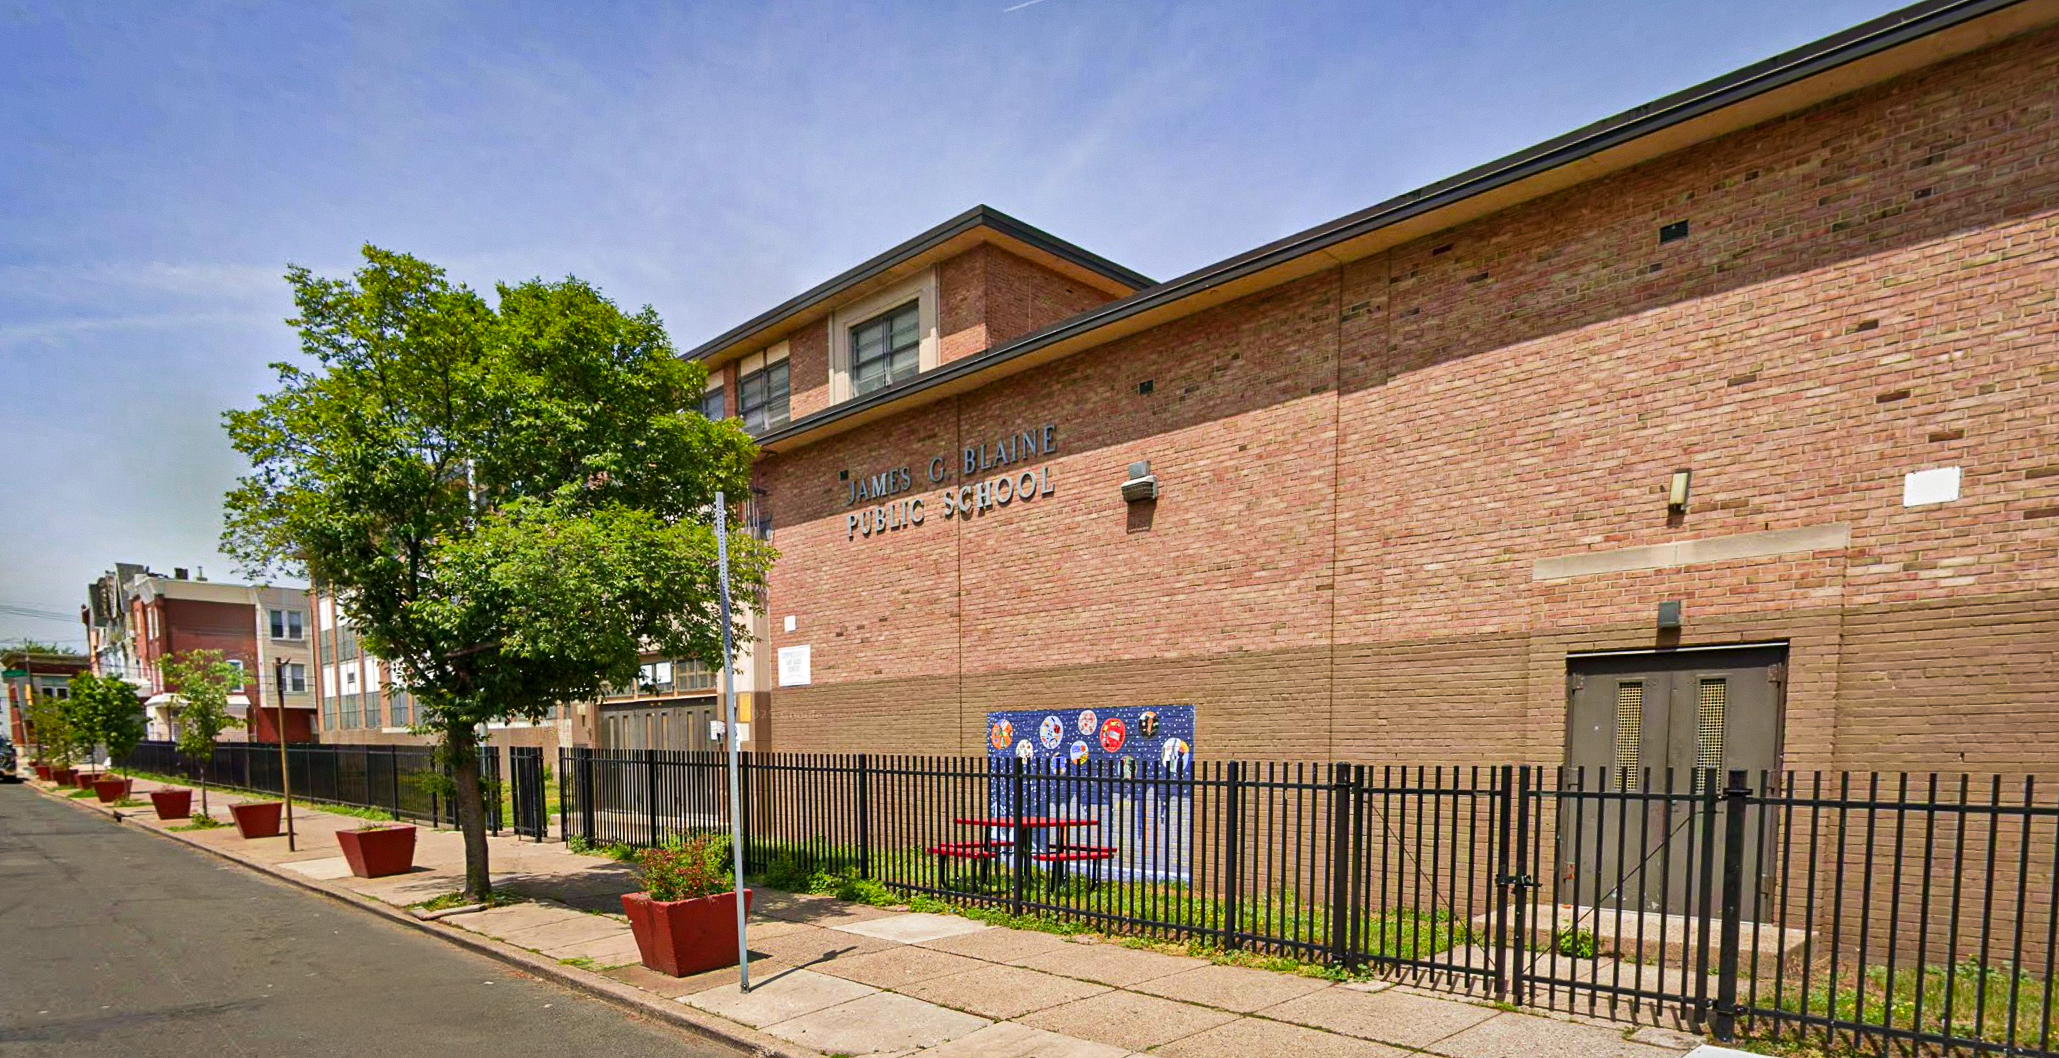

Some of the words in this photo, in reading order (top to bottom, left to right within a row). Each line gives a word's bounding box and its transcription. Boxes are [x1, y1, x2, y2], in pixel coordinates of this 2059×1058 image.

[846, 467, 912, 505] JAMES
[964, 425, 1057, 475] BLAINE
[846, 498, 925, 537] PUBLIC
[943, 469, 1055, 516] SCHOOL
